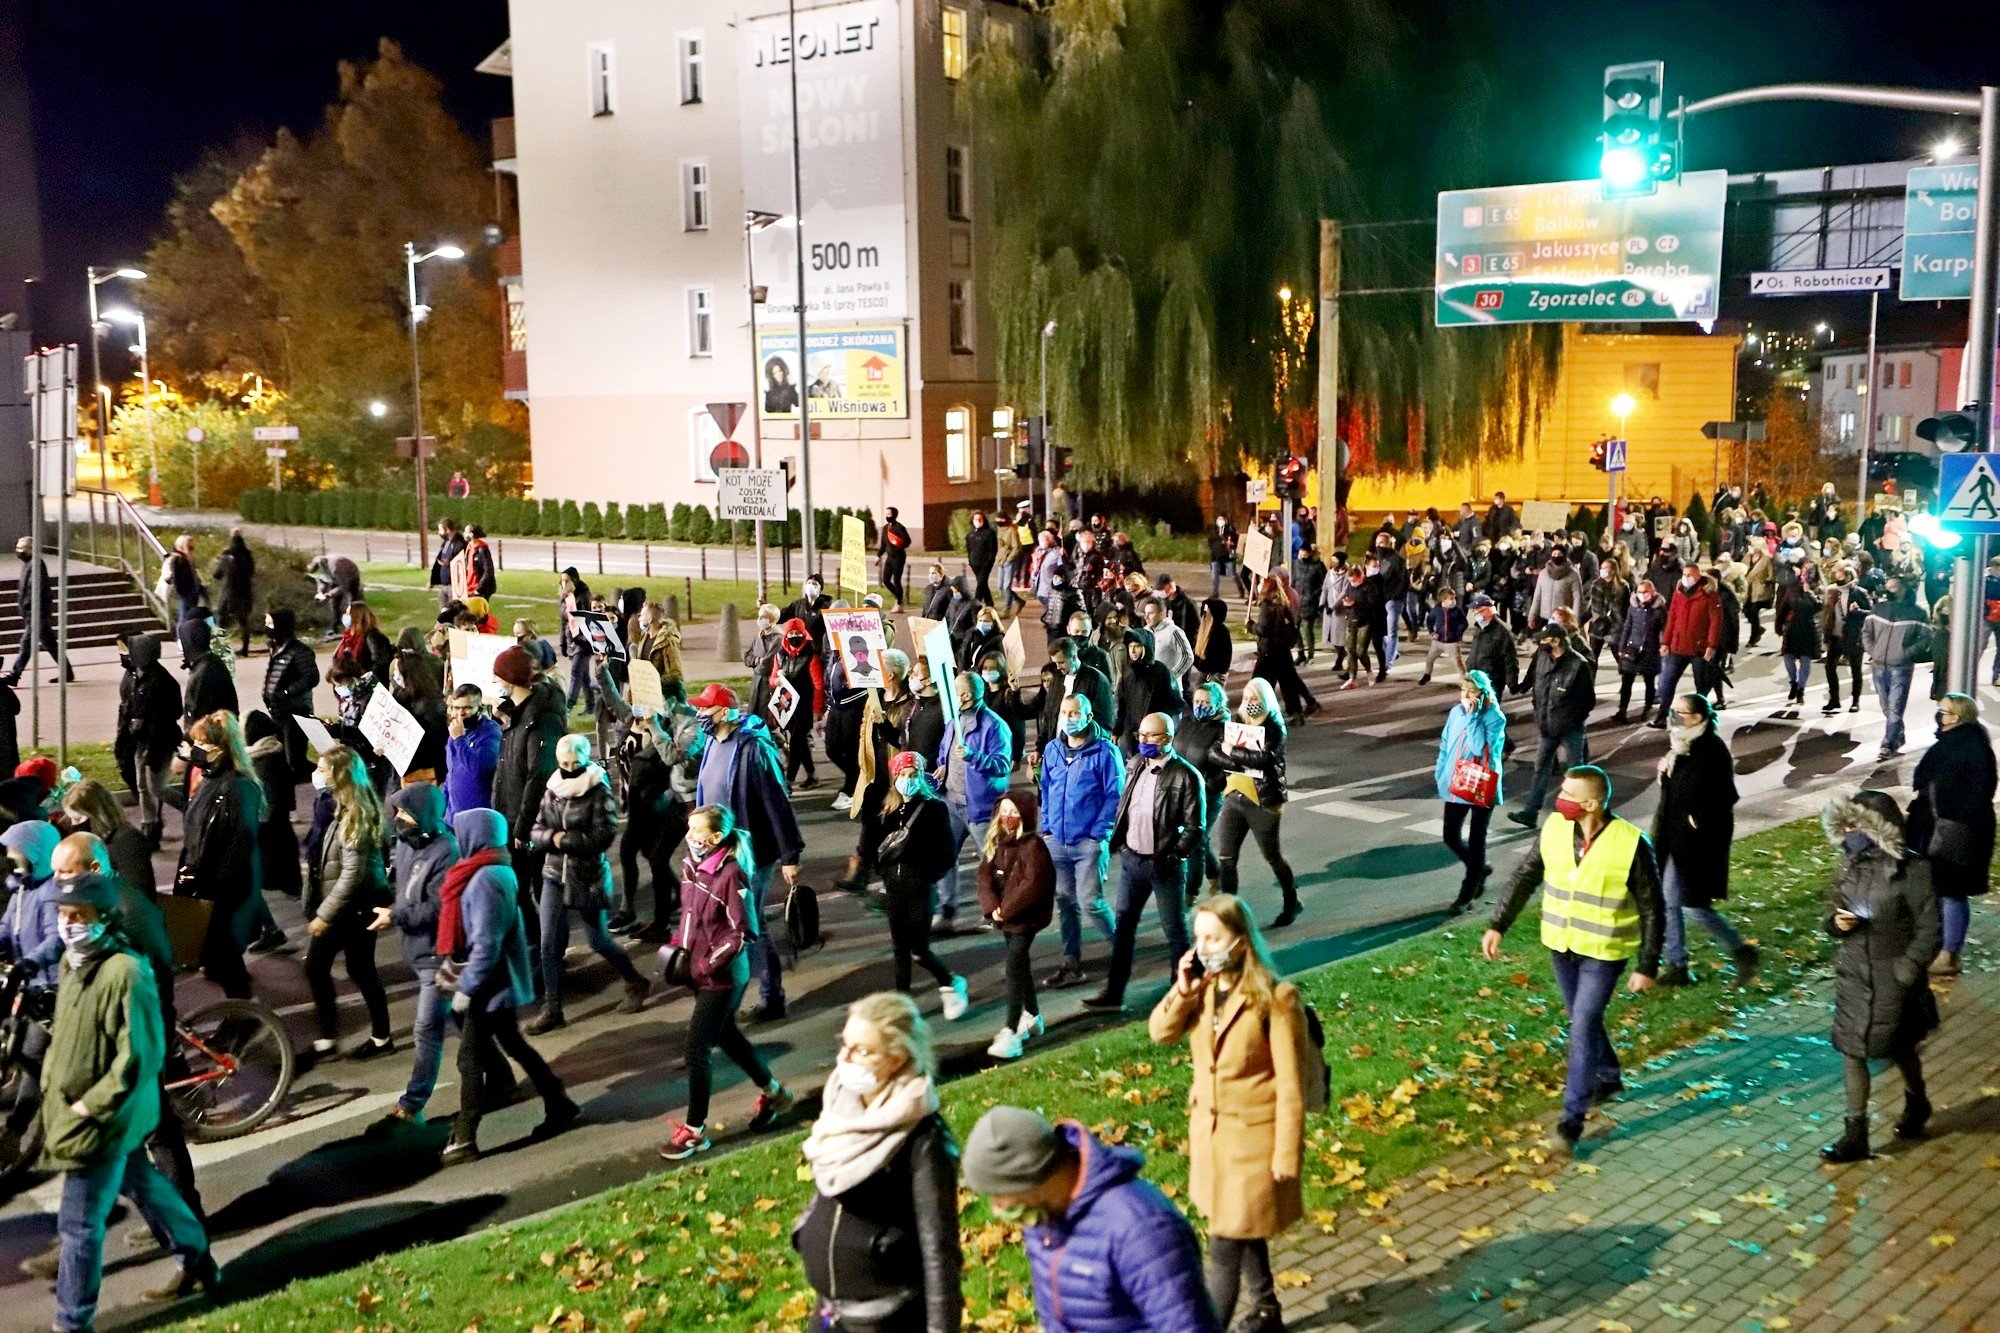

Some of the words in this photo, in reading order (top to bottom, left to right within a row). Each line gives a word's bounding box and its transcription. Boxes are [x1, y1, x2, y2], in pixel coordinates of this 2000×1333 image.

[752, 17, 879, 67] NEONET
[767, 73, 869, 117] NOWY
[761, 110, 879, 154] SALON!
[1493, 208, 1500, 222] E
[1505, 207, 1521, 221] 65
[1533, 241, 1620, 260] Jakuszyce
[1630, 240, 1643, 251] PL
[1658, 237, 1675, 250] CZ
[812, 242, 851, 271] 500
[857, 246, 879, 268] m
[1467, 258, 1476, 272] 3
[1490, 258, 1498, 271] E
[1502, 257, 1519, 271] 65
[836, 283, 854, 293] Jana
[1767, 276, 1789, 288] Os.
[1794, 274, 1873, 287] Robotnicze
[822, 301, 831, 310] 16
[834, 299, 855, 311] (przy
[858, 296, 888, 308] TESCO)
[1480, 294, 1498, 307] 30
[1528, 288, 1617, 311] Zgorzelec
[1627, 293, 1639, 303] PL
[842, 333, 895, 346] SKÓRZANA
[829, 400, 886, 413] Wiśniowa
[892, 400, 898, 412] 1
[725, 476, 742, 486] KOT
[748, 475, 773, 488] MOŻE
[739, 487, 766, 496] ZOSTAĆ
[743, 496, 767, 504] RESZTA
[727, 503, 777, 517] WYPIERDALAĆ
